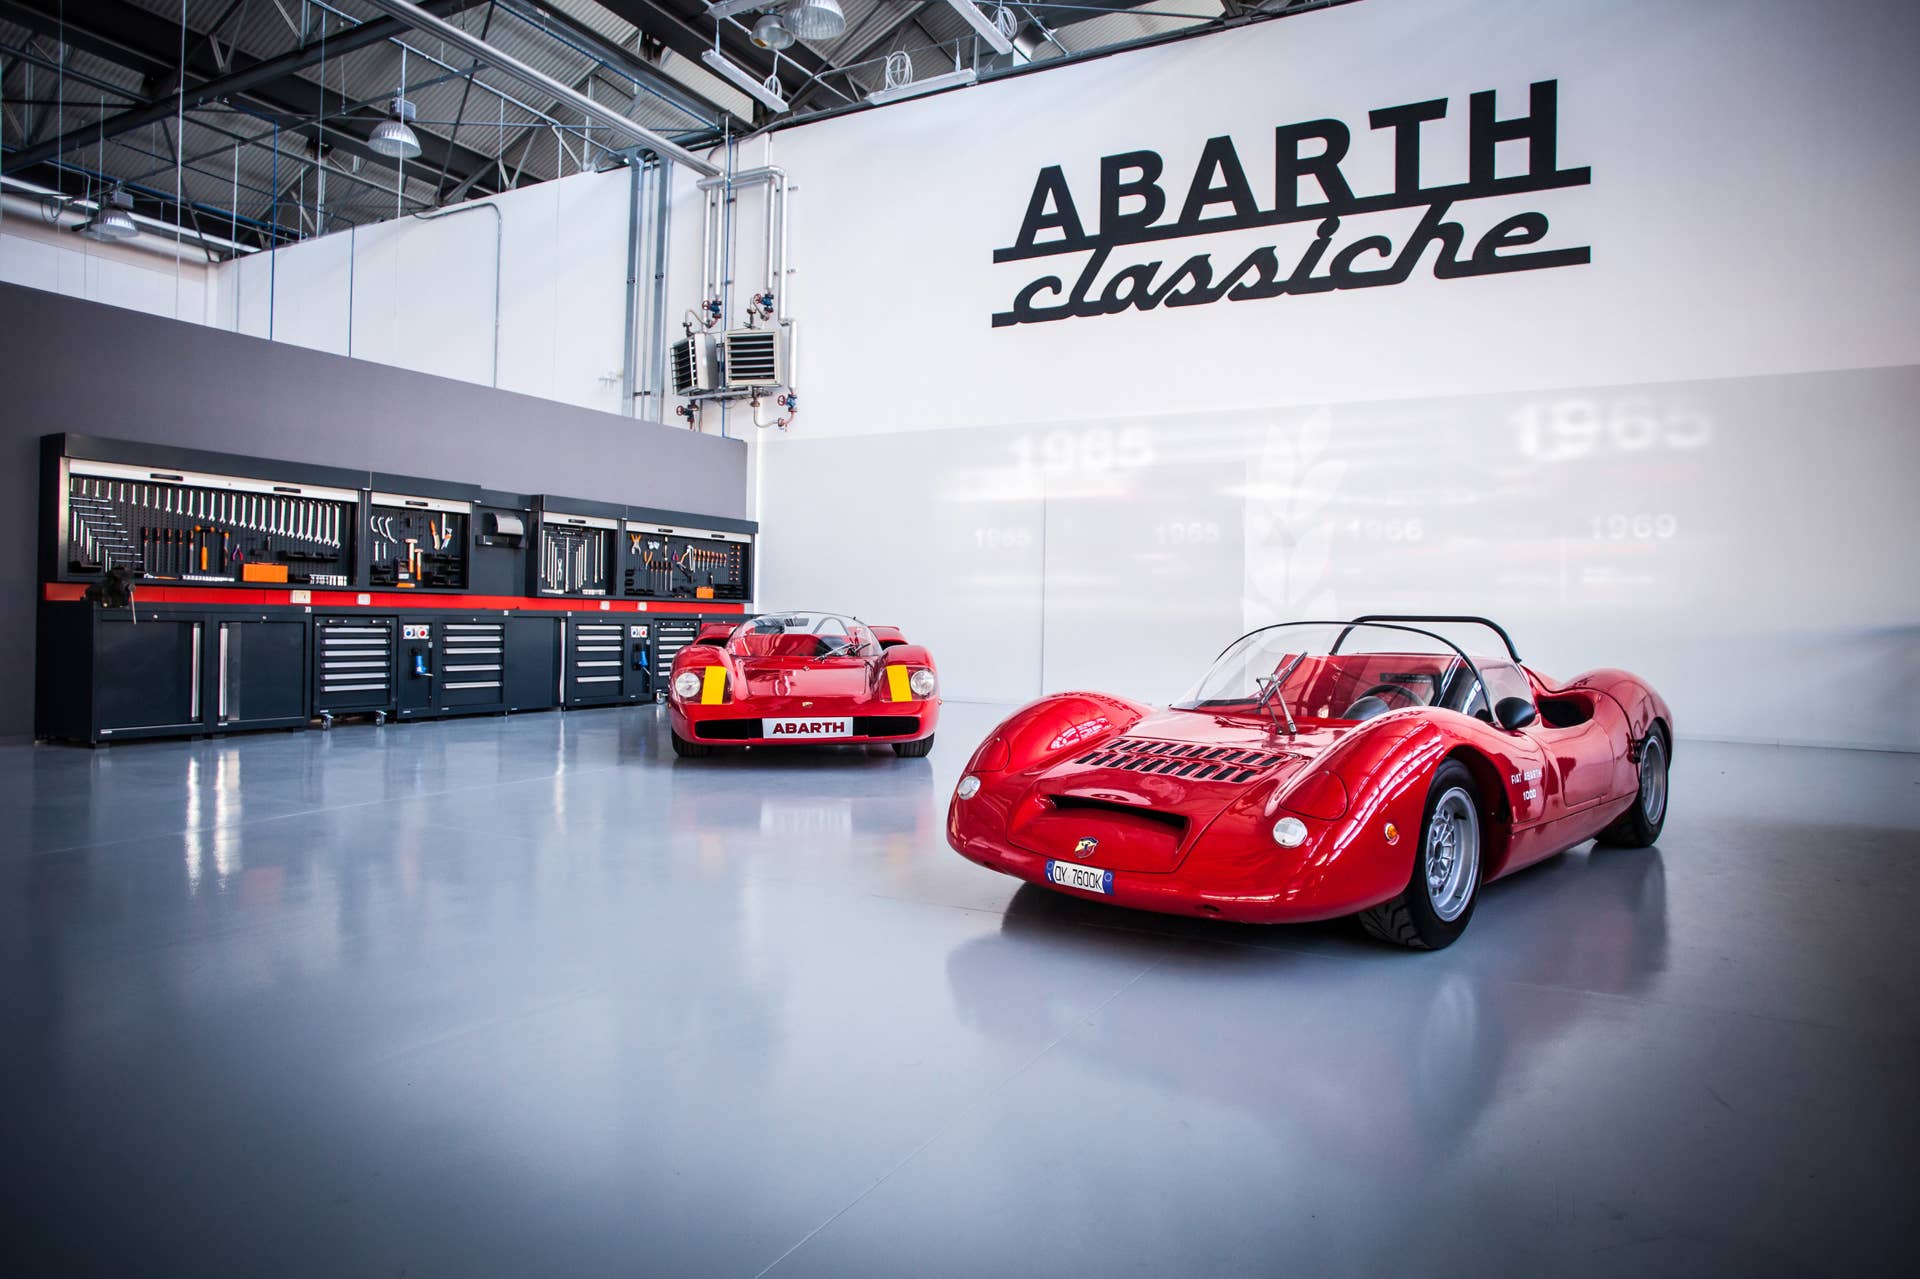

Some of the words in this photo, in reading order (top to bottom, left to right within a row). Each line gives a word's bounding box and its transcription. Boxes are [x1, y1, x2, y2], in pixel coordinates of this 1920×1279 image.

[993, 80, 1590, 262] ABARTH
[992, 201, 1590, 326] classiche
[1587, 513, 1677, 540] 1969
[772, 722, 845, 734] ABARTH
[1511, 773, 1521, 784] FIAT
[1523, 788, 1536, 800] 1000
